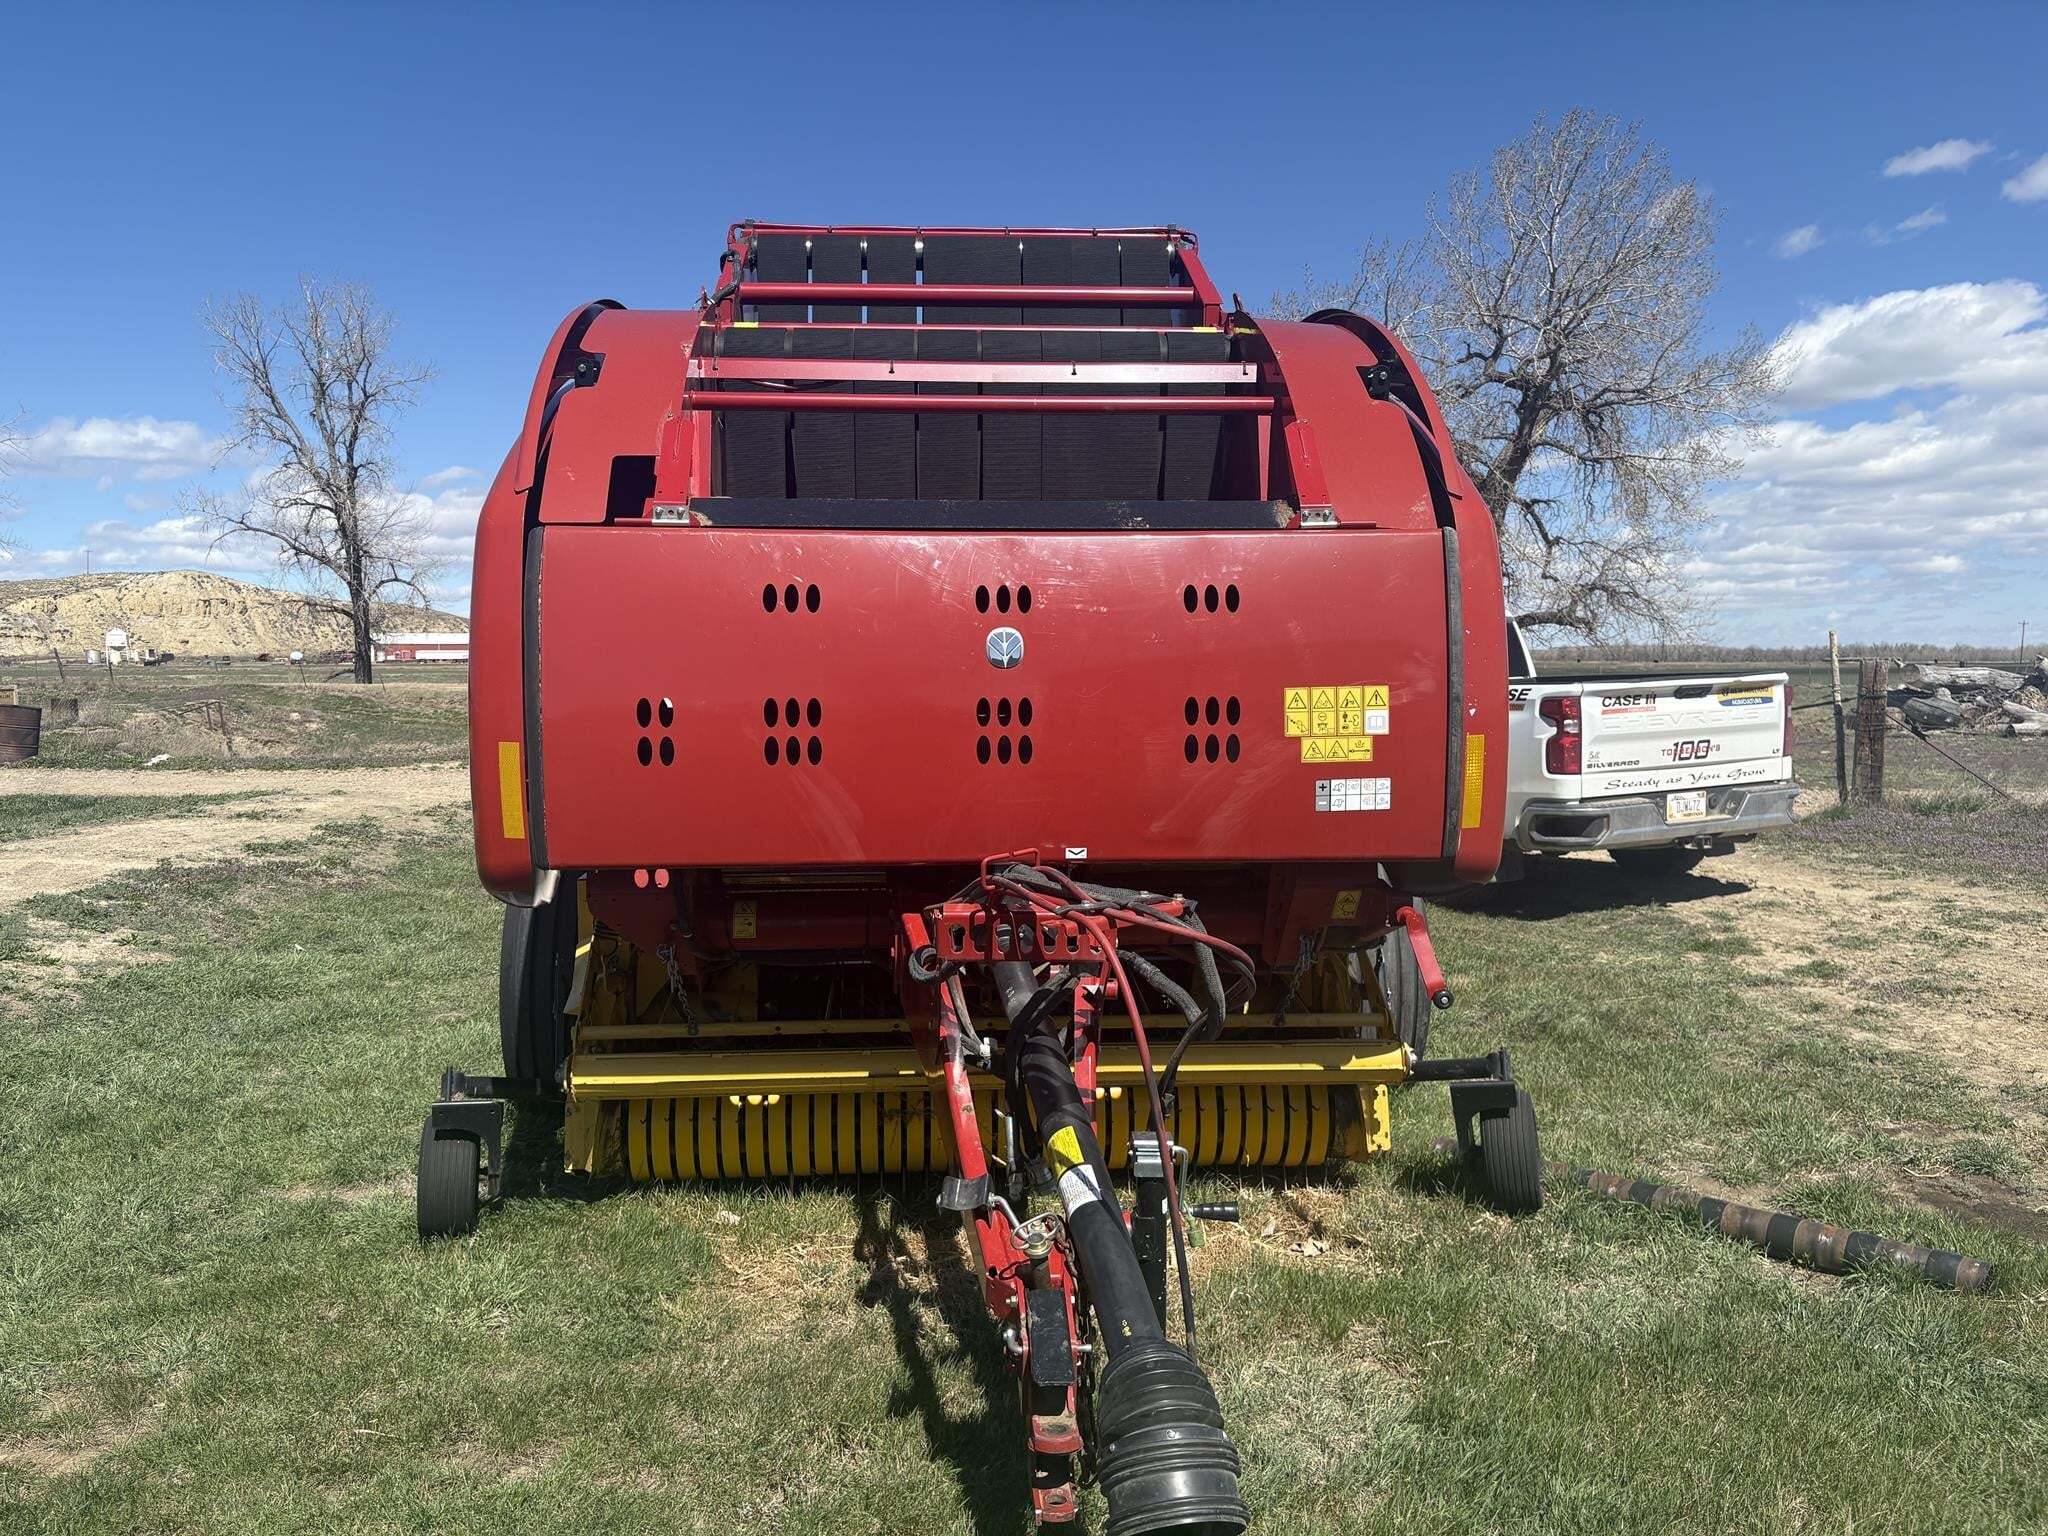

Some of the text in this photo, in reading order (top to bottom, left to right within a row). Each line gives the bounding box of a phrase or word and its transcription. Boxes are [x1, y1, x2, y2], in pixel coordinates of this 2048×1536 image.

[1602, 694, 1642, 707] CASE
[1672, 739, 1710, 762] 100
[1586, 760, 1640, 768] SILVERADO
[1604, 768, 1766, 790] Steady as You Grow
